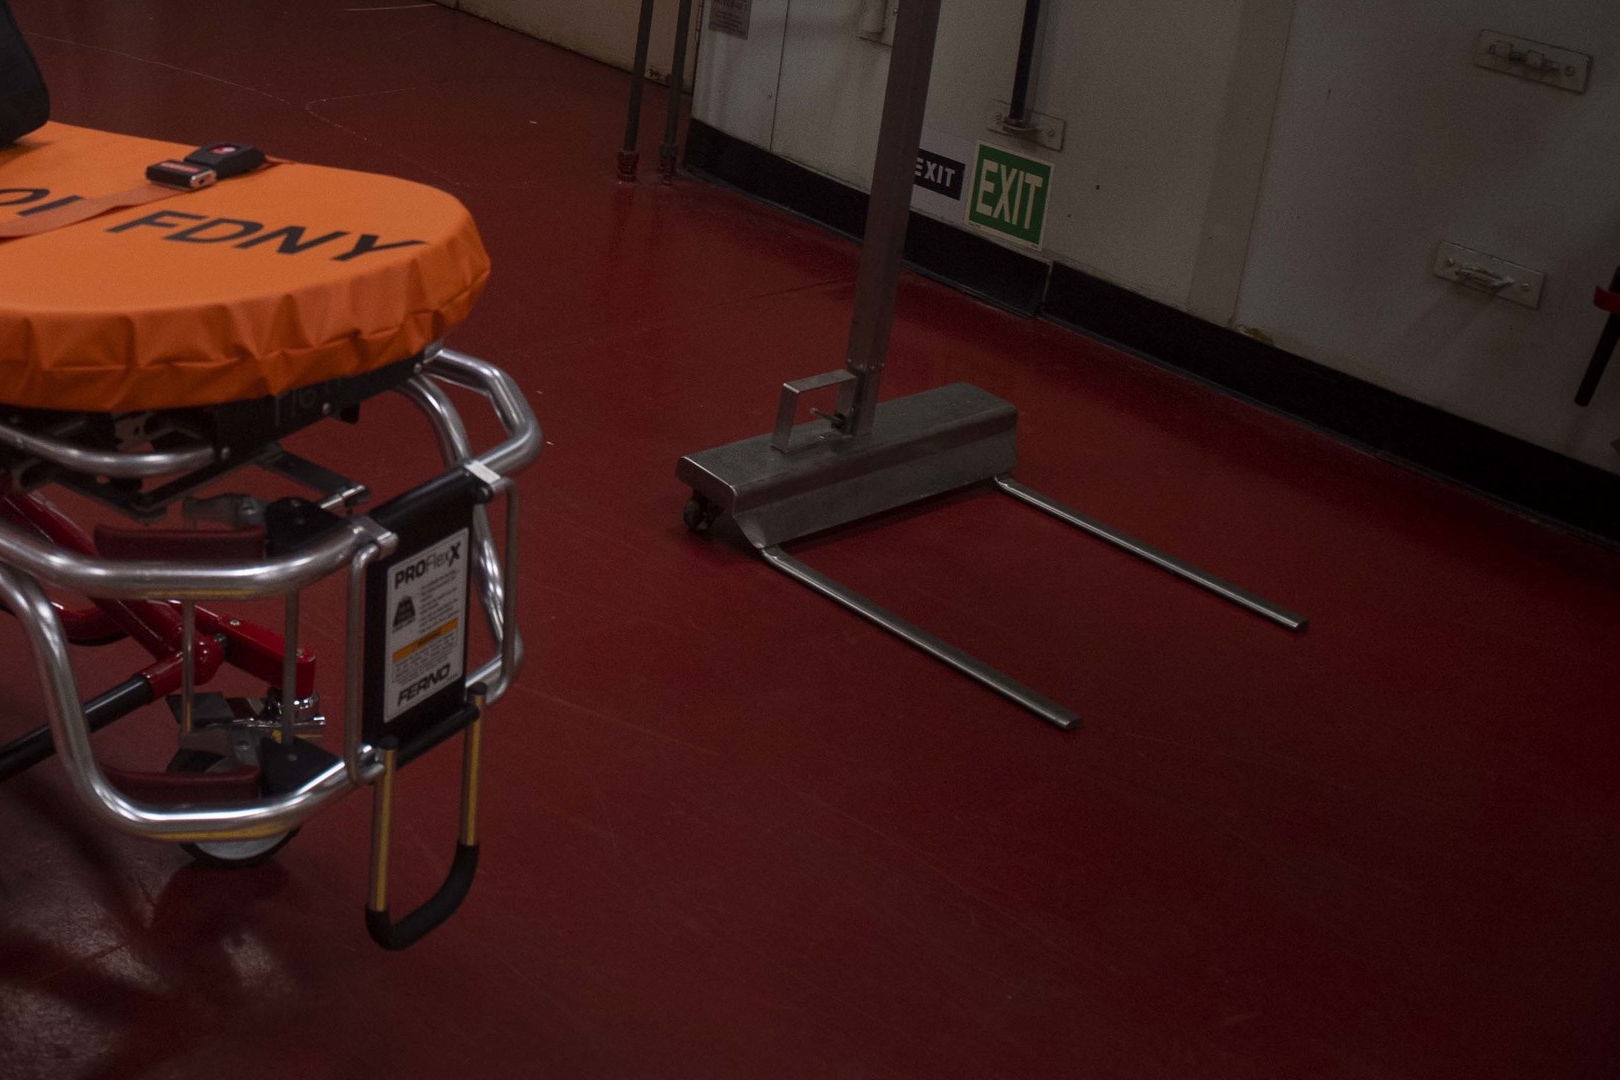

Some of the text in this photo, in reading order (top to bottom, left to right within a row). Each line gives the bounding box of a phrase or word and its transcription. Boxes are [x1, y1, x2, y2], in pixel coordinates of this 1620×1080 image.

[975, 158, 1044, 230] EXIT
[106, 208, 430, 263] FDNY
[394, 542, 461, 590] PROFlexX
[397, 663, 452, 707] FERNO
